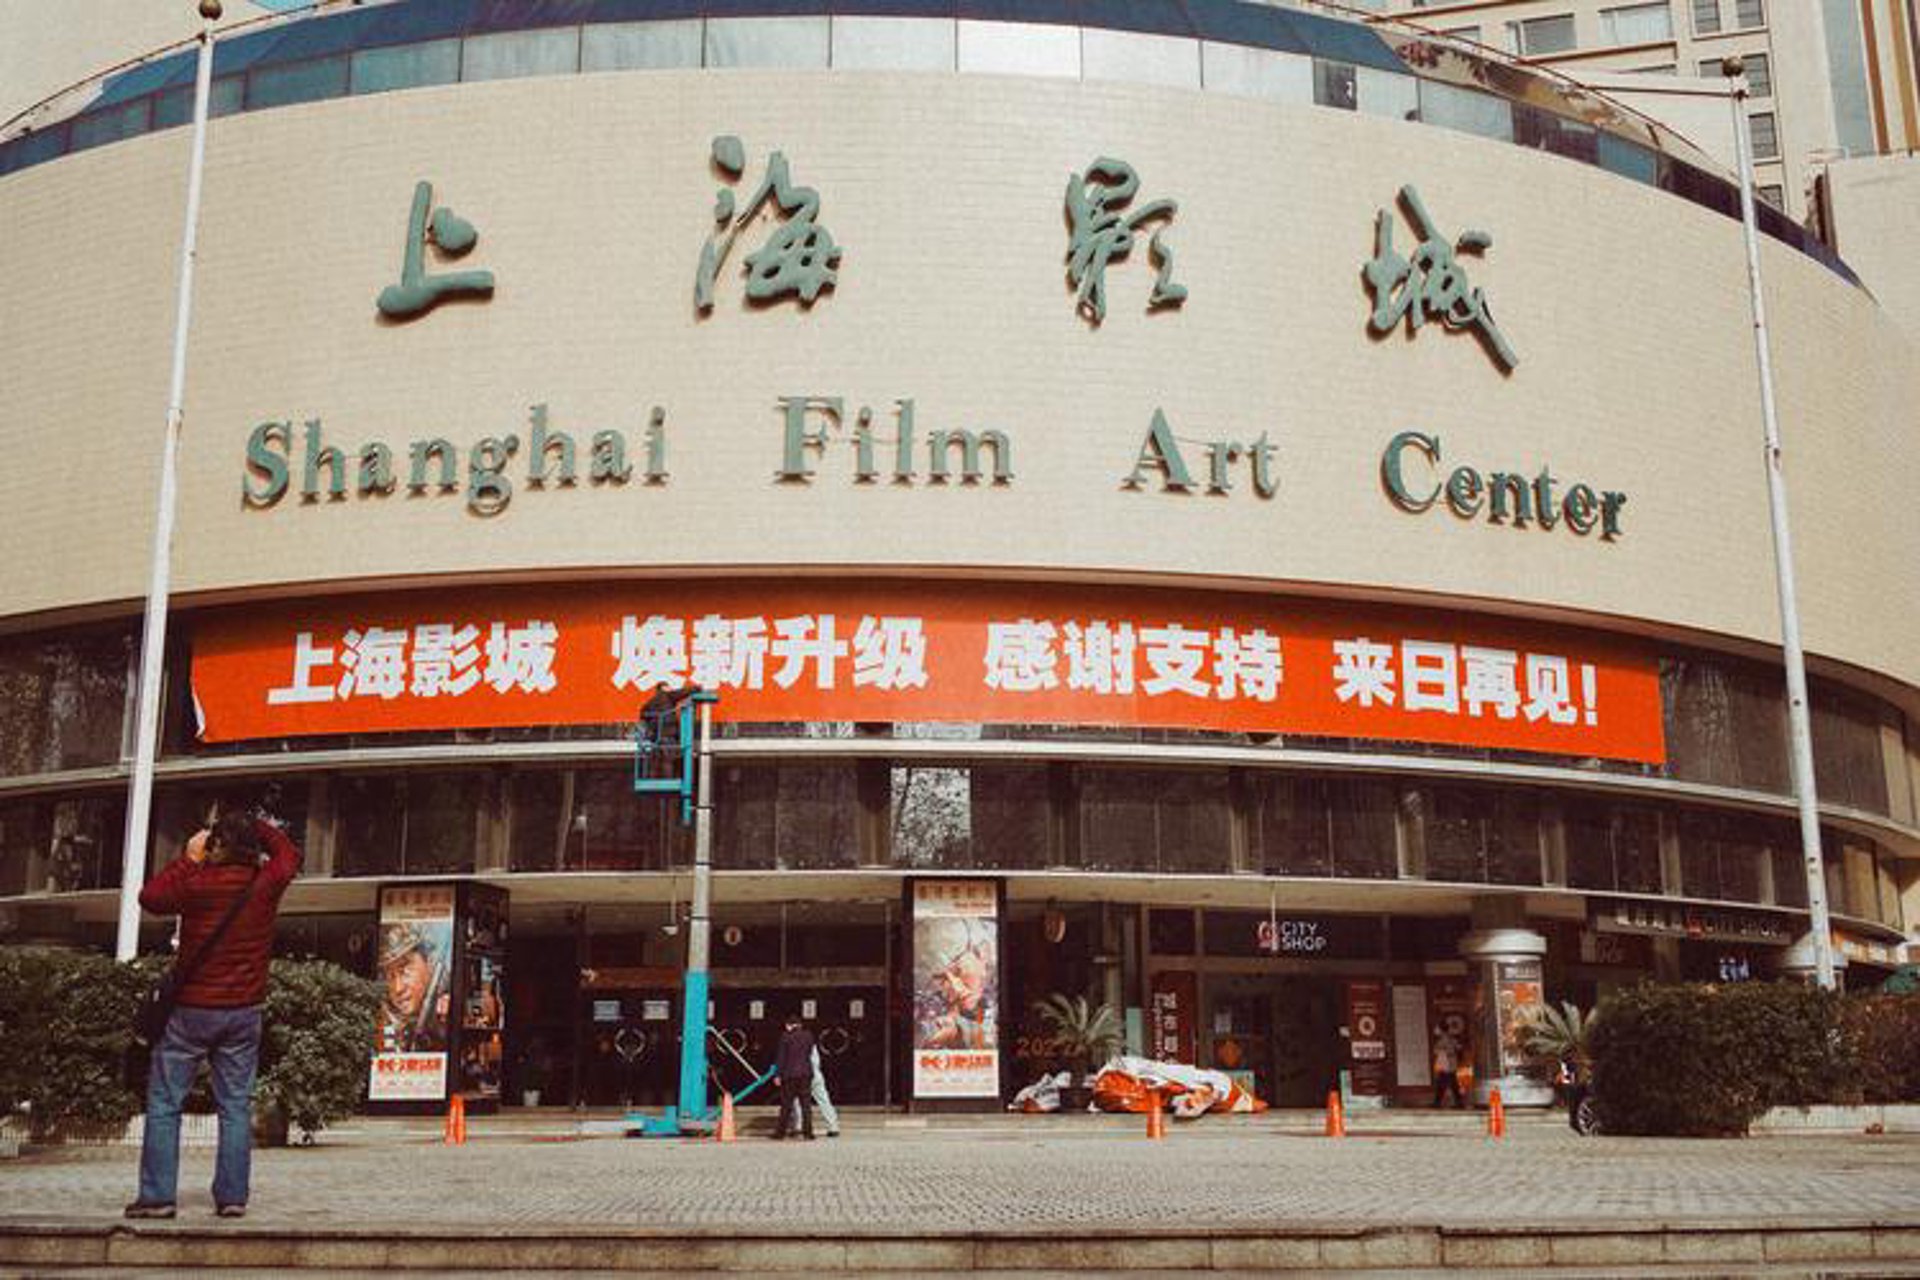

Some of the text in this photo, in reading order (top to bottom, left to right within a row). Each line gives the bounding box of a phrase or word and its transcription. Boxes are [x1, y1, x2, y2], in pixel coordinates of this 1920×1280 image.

[374, 135, 1518, 372] 上海影城
[243, 396, 1627, 543] Shanghai Film Art Center
[268, 618, 560, 705] 上海影城
[610, 614, 930, 690] 焕新升级
[983, 618, 1285, 702] 感谢支持
[1281, 936, 1328, 951] SHOP
